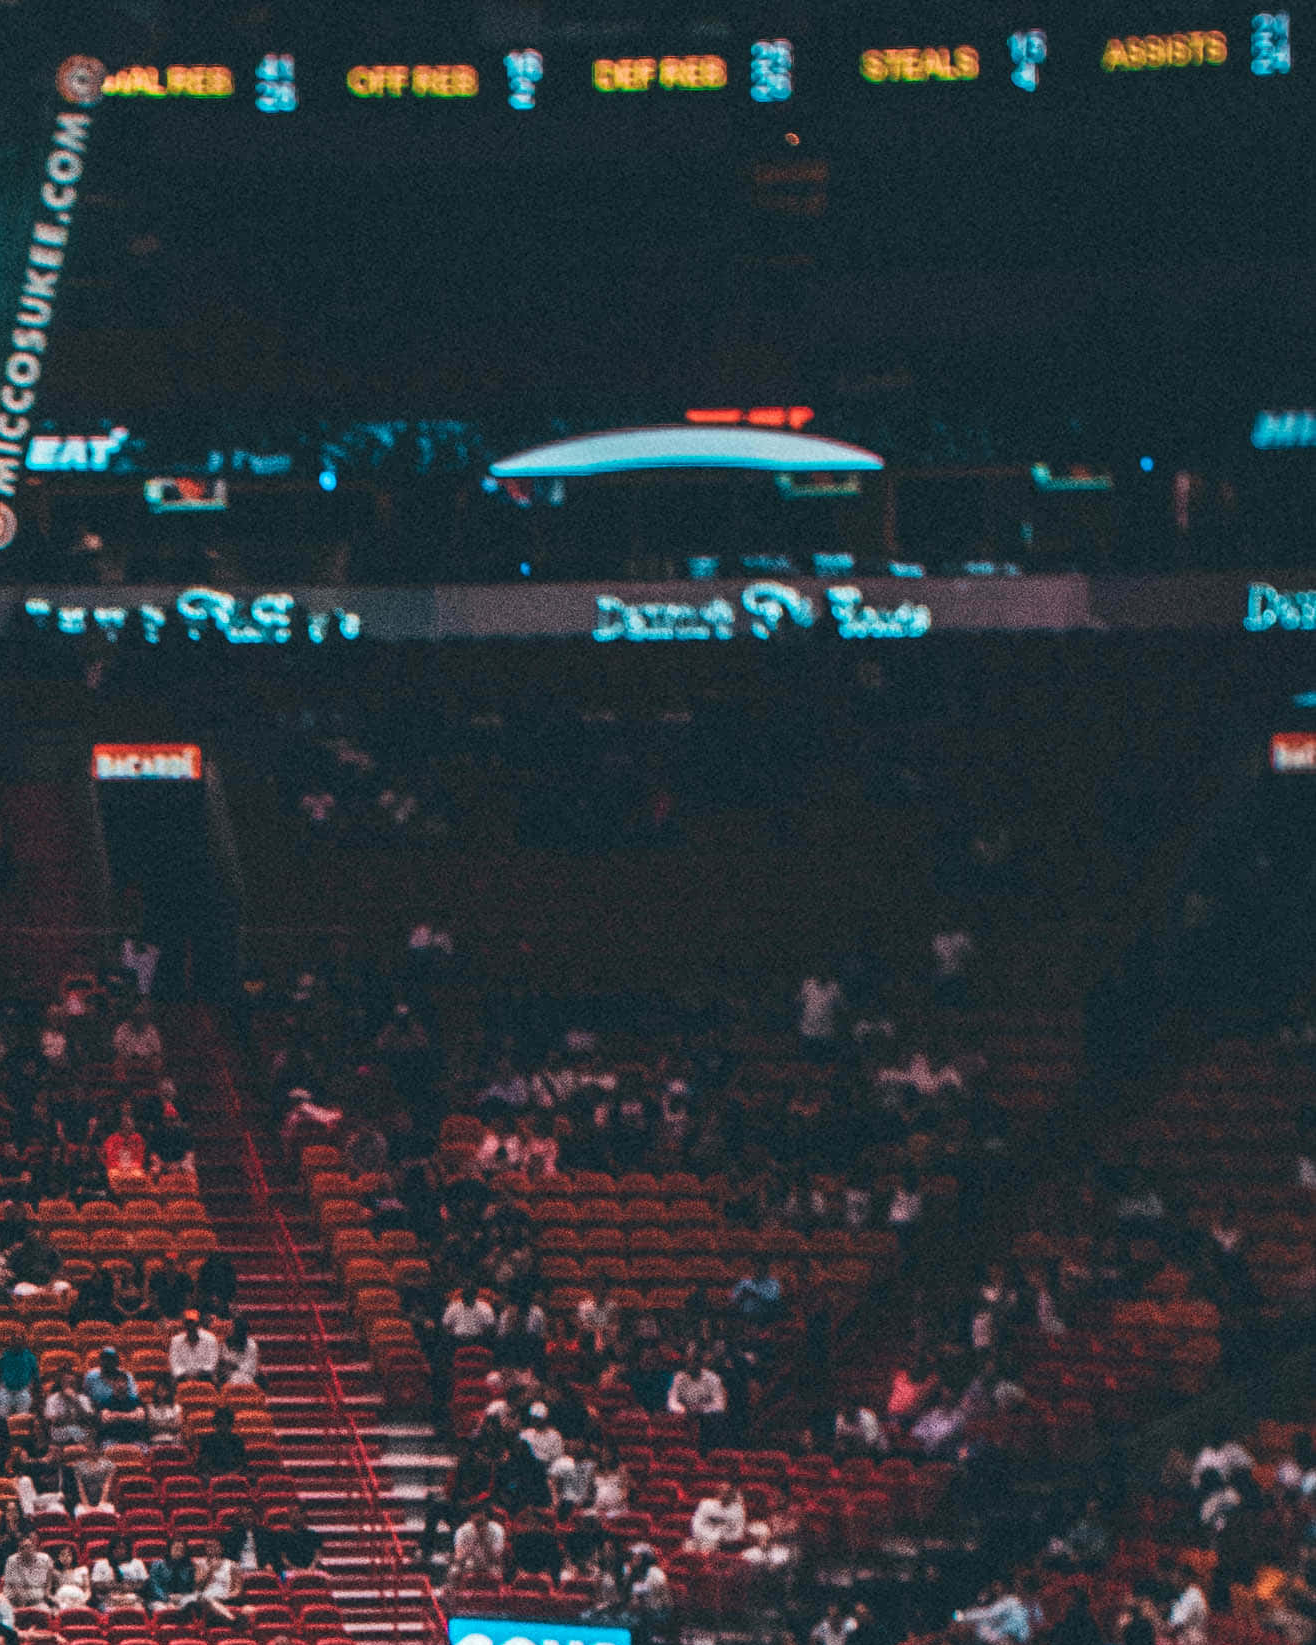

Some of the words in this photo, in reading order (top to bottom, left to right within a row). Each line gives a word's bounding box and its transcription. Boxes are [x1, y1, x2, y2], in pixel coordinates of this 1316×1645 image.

[859, 44, 980, 84] STEALS
[1100, 29, 1229, 71] ASSISTS
[26, 433, 128, 471] EAT
